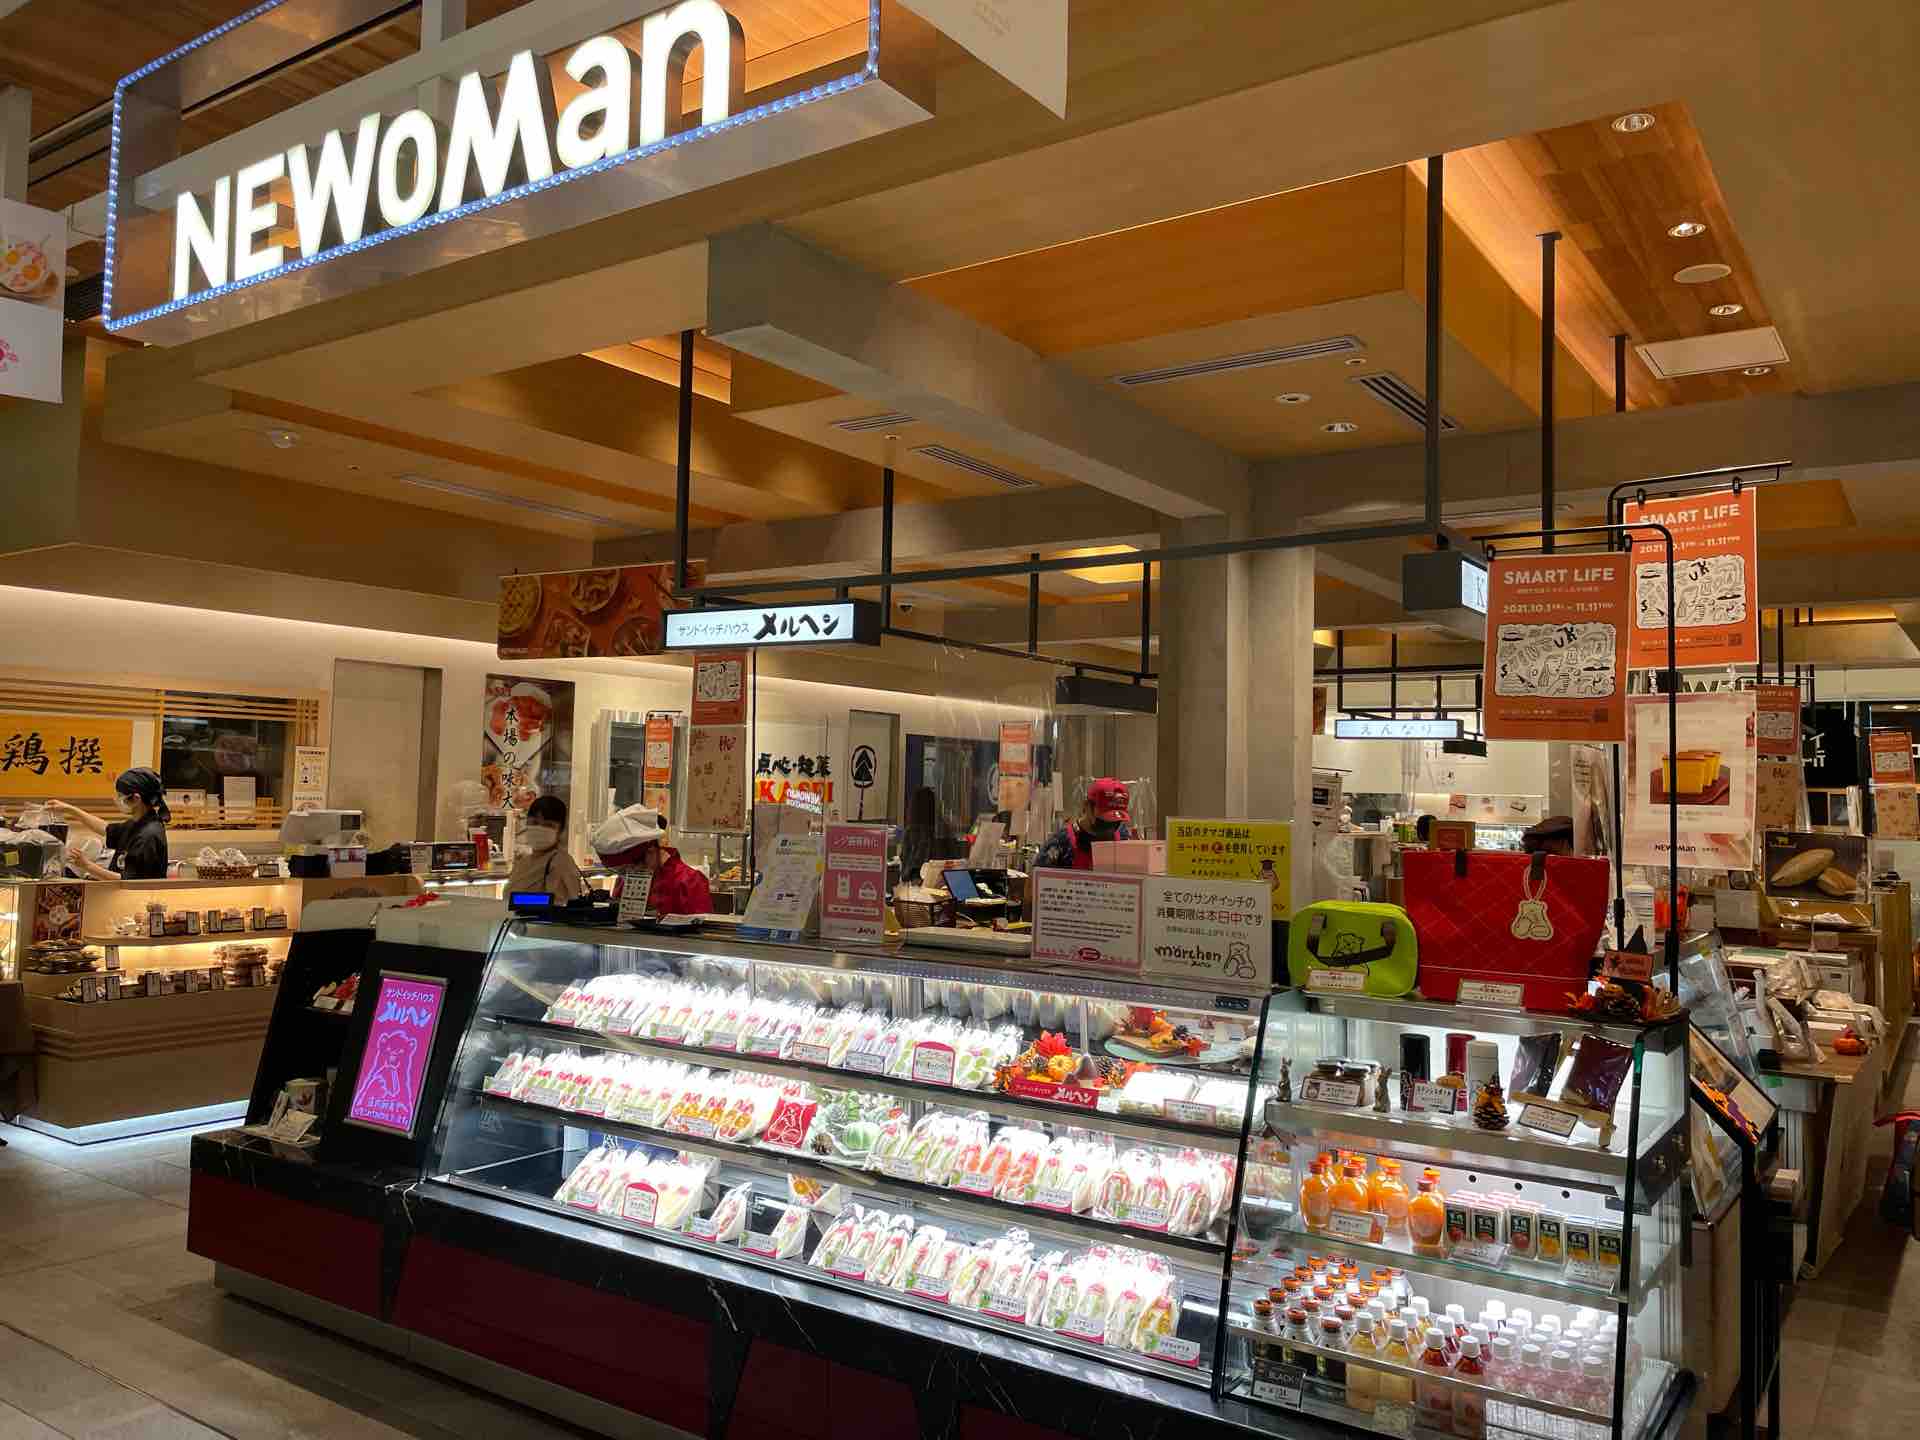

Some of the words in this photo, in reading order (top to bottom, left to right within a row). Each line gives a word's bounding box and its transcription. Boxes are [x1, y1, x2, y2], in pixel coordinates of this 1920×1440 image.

[173, 0, 736, 302] NEWoMan
[1640, 509, 1700, 525] SMART
[1704, 504, 1742, 520] LIFE
[1503, 569, 1568, 585] SMART
[1574, 567, 1616, 582] LIFE
[677, 622, 750, 638] サンドイッチハウス
[753, 612, 841, 641] メルヘン
[1162, 889, 1257, 910] 全てのサンドイッチの
[1156, 907, 1265, 927] 消費期限は本日中です
[376, 1001, 433, 1028] メルヘン
